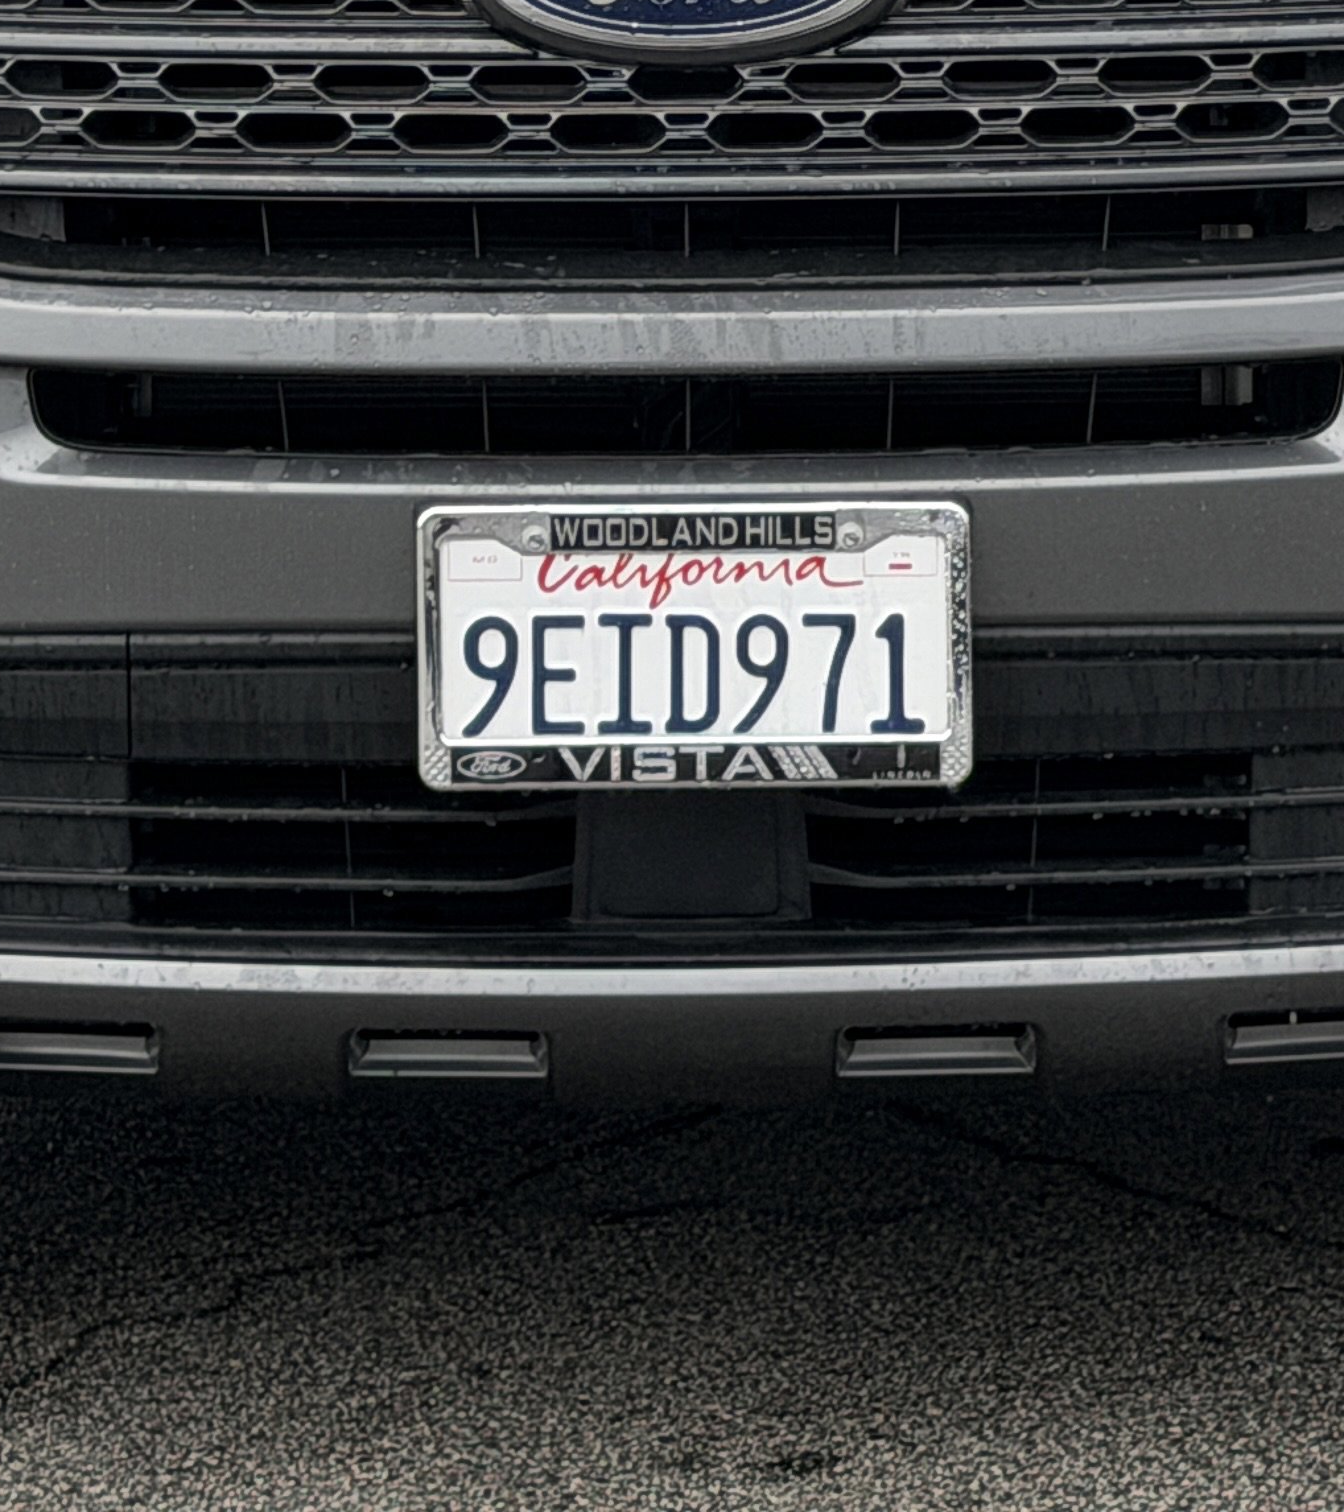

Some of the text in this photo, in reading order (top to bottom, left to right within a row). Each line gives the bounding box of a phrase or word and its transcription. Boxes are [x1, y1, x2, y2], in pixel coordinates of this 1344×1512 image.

[554, 515, 833, 547] WOODLAND HILLS
[537, 553, 864, 610] California
[461, 612, 927, 738] 9EID971
[558, 745, 774, 782] VISTA
